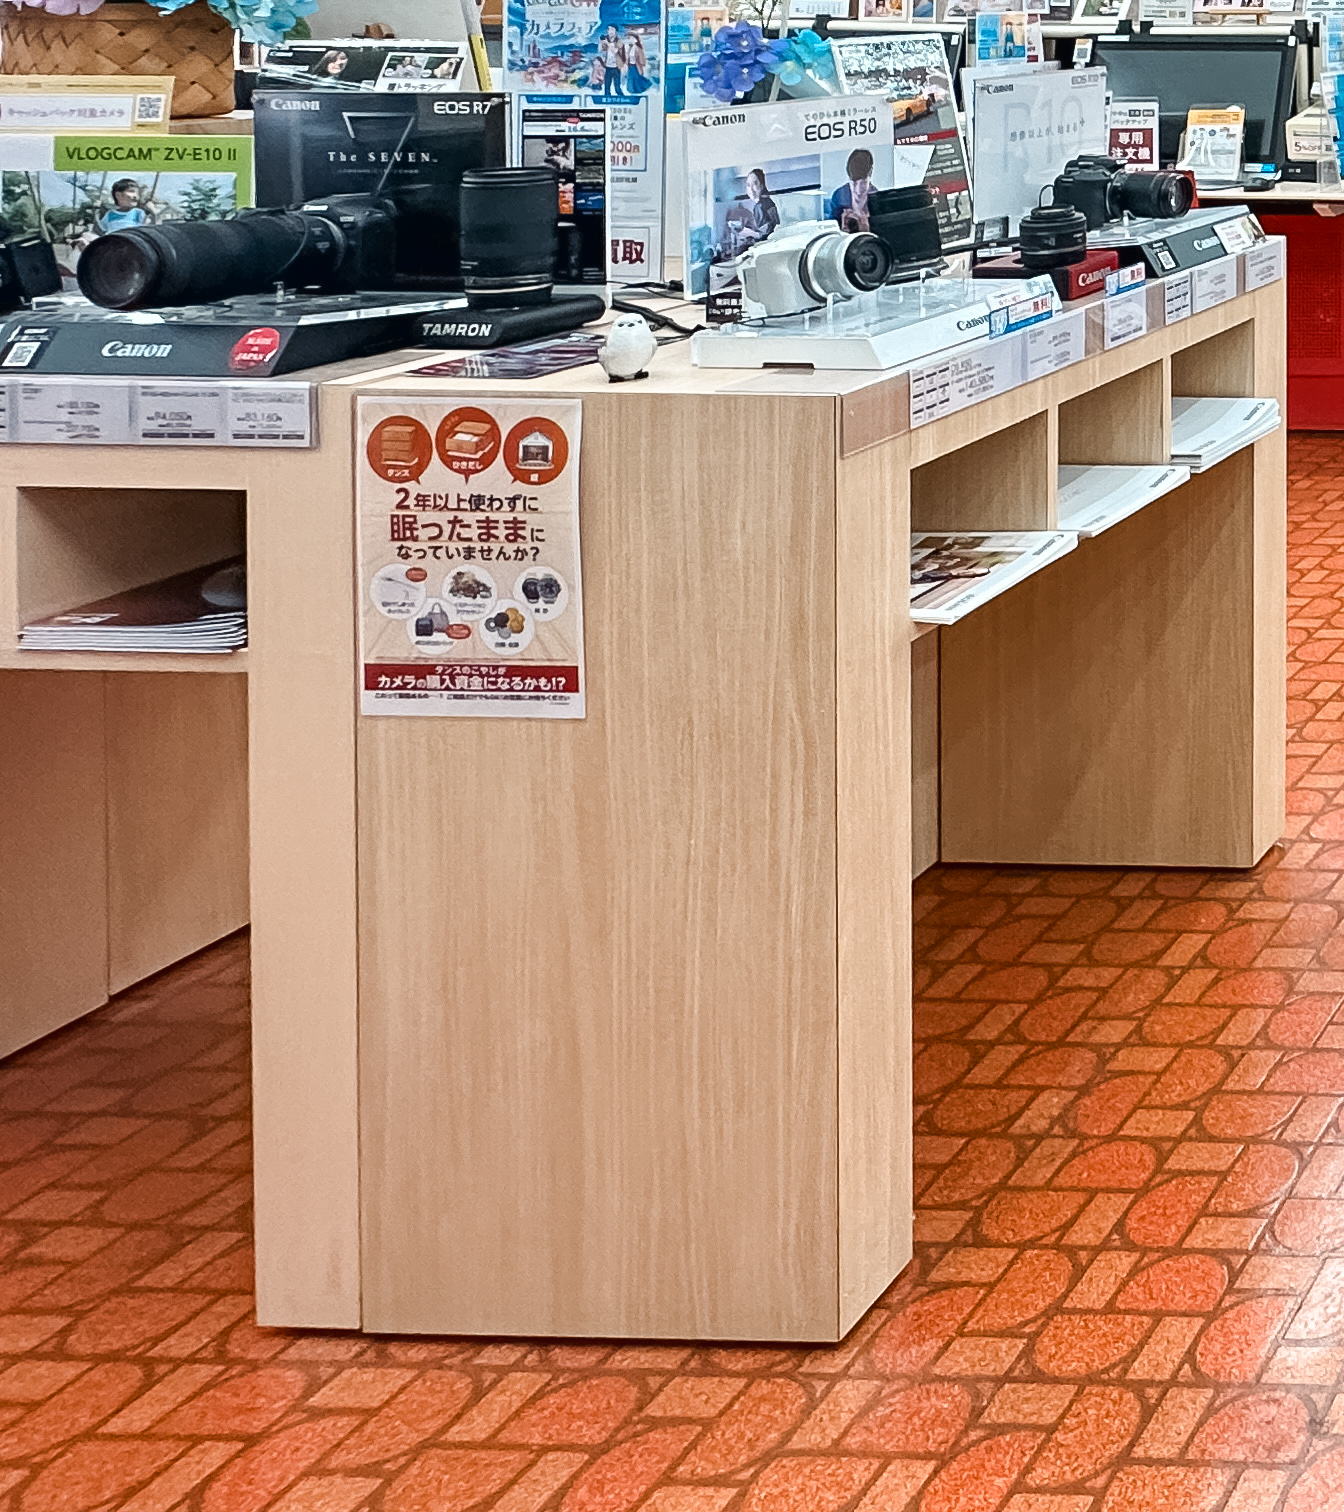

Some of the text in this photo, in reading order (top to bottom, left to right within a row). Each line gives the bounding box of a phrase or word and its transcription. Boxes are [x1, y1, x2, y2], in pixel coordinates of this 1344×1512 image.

[270, 99, 491, 115] Canon EOS R7
[702, 113, 877, 142] Canon EOS R50
[1118, 131, 1144, 144] 専用
[163, 147, 222, 161] ZV-E10
[328, 151, 357, 162] The
[1111, 146, 1150, 159] 注文機
[422, 323, 493, 337] TAMRON
[101, 340, 173, 358] Canon
[387, 468, 410, 477] タンス
[452, 461, 484, 470] ひきだし
[395, 487, 539, 512] 2年以上使わずに
[390, 514, 545, 543] 眠ったままに
[396, 544, 540, 561] なっていませんか?
[435, 665, 507, 675] タンスのこやしが
